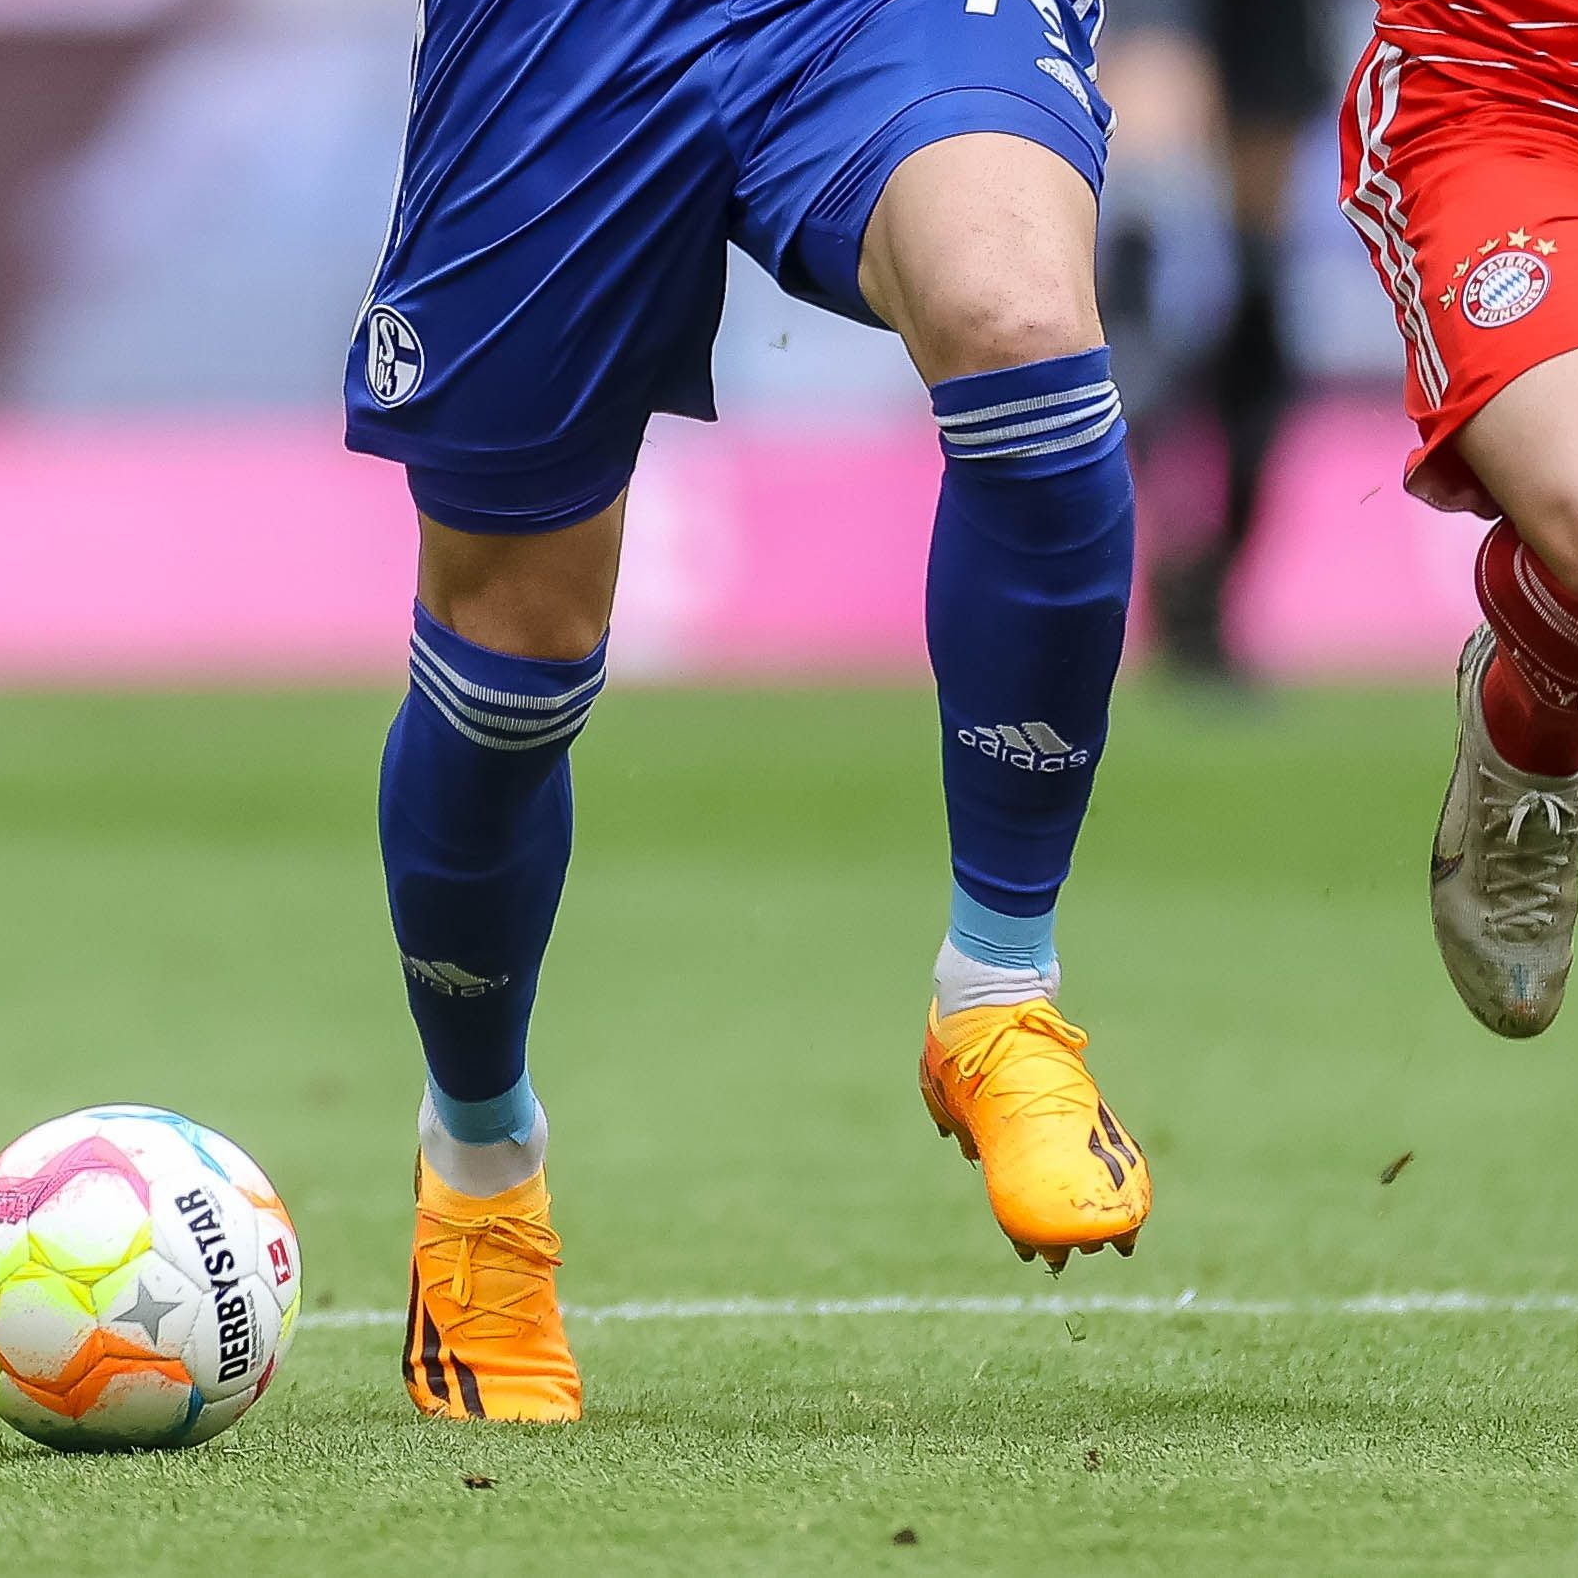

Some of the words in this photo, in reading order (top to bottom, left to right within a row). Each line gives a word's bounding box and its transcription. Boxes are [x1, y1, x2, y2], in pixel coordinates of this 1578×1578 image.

[1476, 255, 1538, 281] BAYERN
[958, 728, 1091, 773] adidas
[175, 1188, 250, 1384] DERBYSTAR
